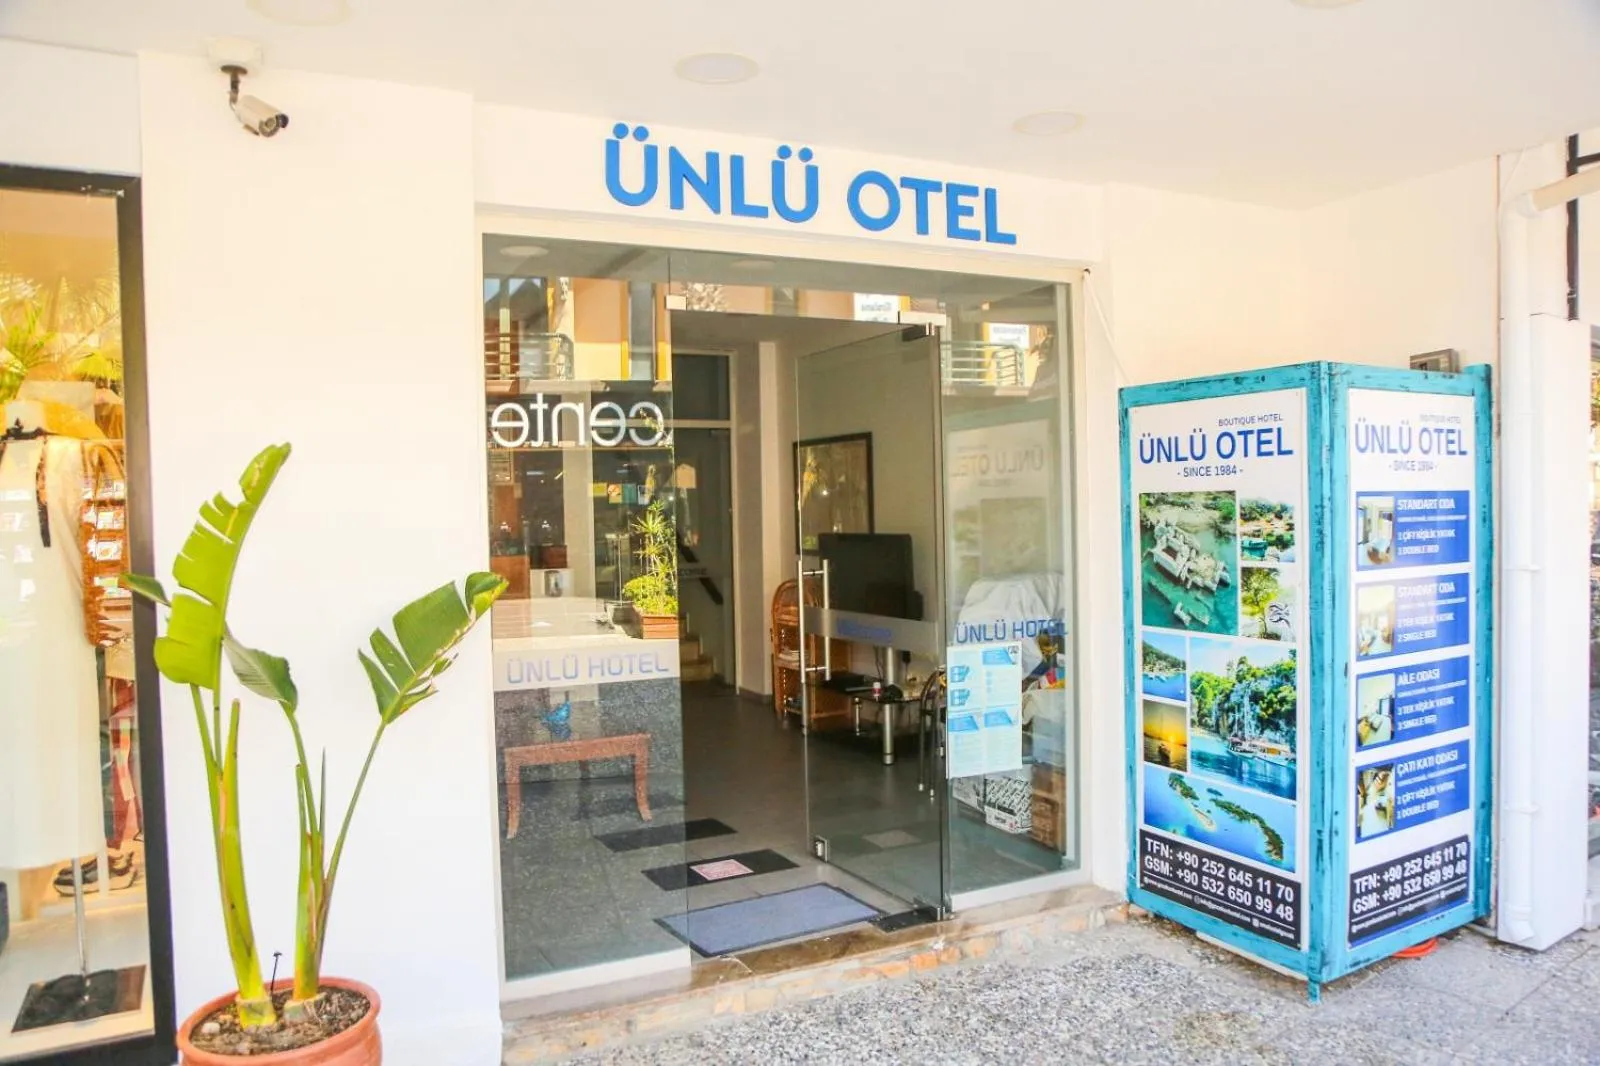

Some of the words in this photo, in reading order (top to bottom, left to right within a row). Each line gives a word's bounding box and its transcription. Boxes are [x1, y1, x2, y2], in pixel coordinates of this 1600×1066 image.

[605, 122, 819, 223] ÜNLÜ
[847, 170, 1017, 245] OTEL
[1218, 415, 1256, 427] BOUTIQUE
[1257, 413, 1283, 423] HOTEL
[1355, 416, 1412, 455] ÜNLÜ
[1418, 426, 1468, 456] OTEL
[1139, 428, 1207, 464] ÜNLÜ
[1215, 426, 1293, 460] OTEL
[1183, 466, 1212, 477] SINCE
[1214, 464, 1237, 476] 1984
[955, 618, 1007, 644] ÜNLÜ
[1012, 616, 1068, 638] HOTEL
[507, 654, 579, 684] ÜNLÜ
[588, 652, 669, 679] HOTEL
[1145, 837, 1174, 860] TFN:
[1176, 850, 1198, 868] +90
[1201, 858, 1225, 878] 252
[1228, 867, 1253, 888] 645
[1256, 876, 1272, 895] 11
[1276, 883, 1294, 902] 70
[1353, 892, 1380, 914] GSM:
[1382, 884, 1402, 901] +90
[1403, 876, 1422, 896] 532
[1423, 869, 1441, 888] 650
[1442, 864, 1454, 881] 99
[1455, 859, 1467, 875] 48
[1354, 873, 1380, 894] TFN:
[1383, 865, 1402, 882] +90
[1404, 858, 1422, 877] 252
[1424, 850, 1442, 869] 645
[1443, 846, 1454, 862] 11
[1456, 841, 1467, 858] 70
[1144, 855, 1174, 877] GSM:
[1176, 868, 1198, 886] +90
[1201, 876, 1225, 896] 532
[1227, 885, 1252, 906] 650
[1255, 895, 1272, 914] 99
[1275, 903, 1294, 922] 48
